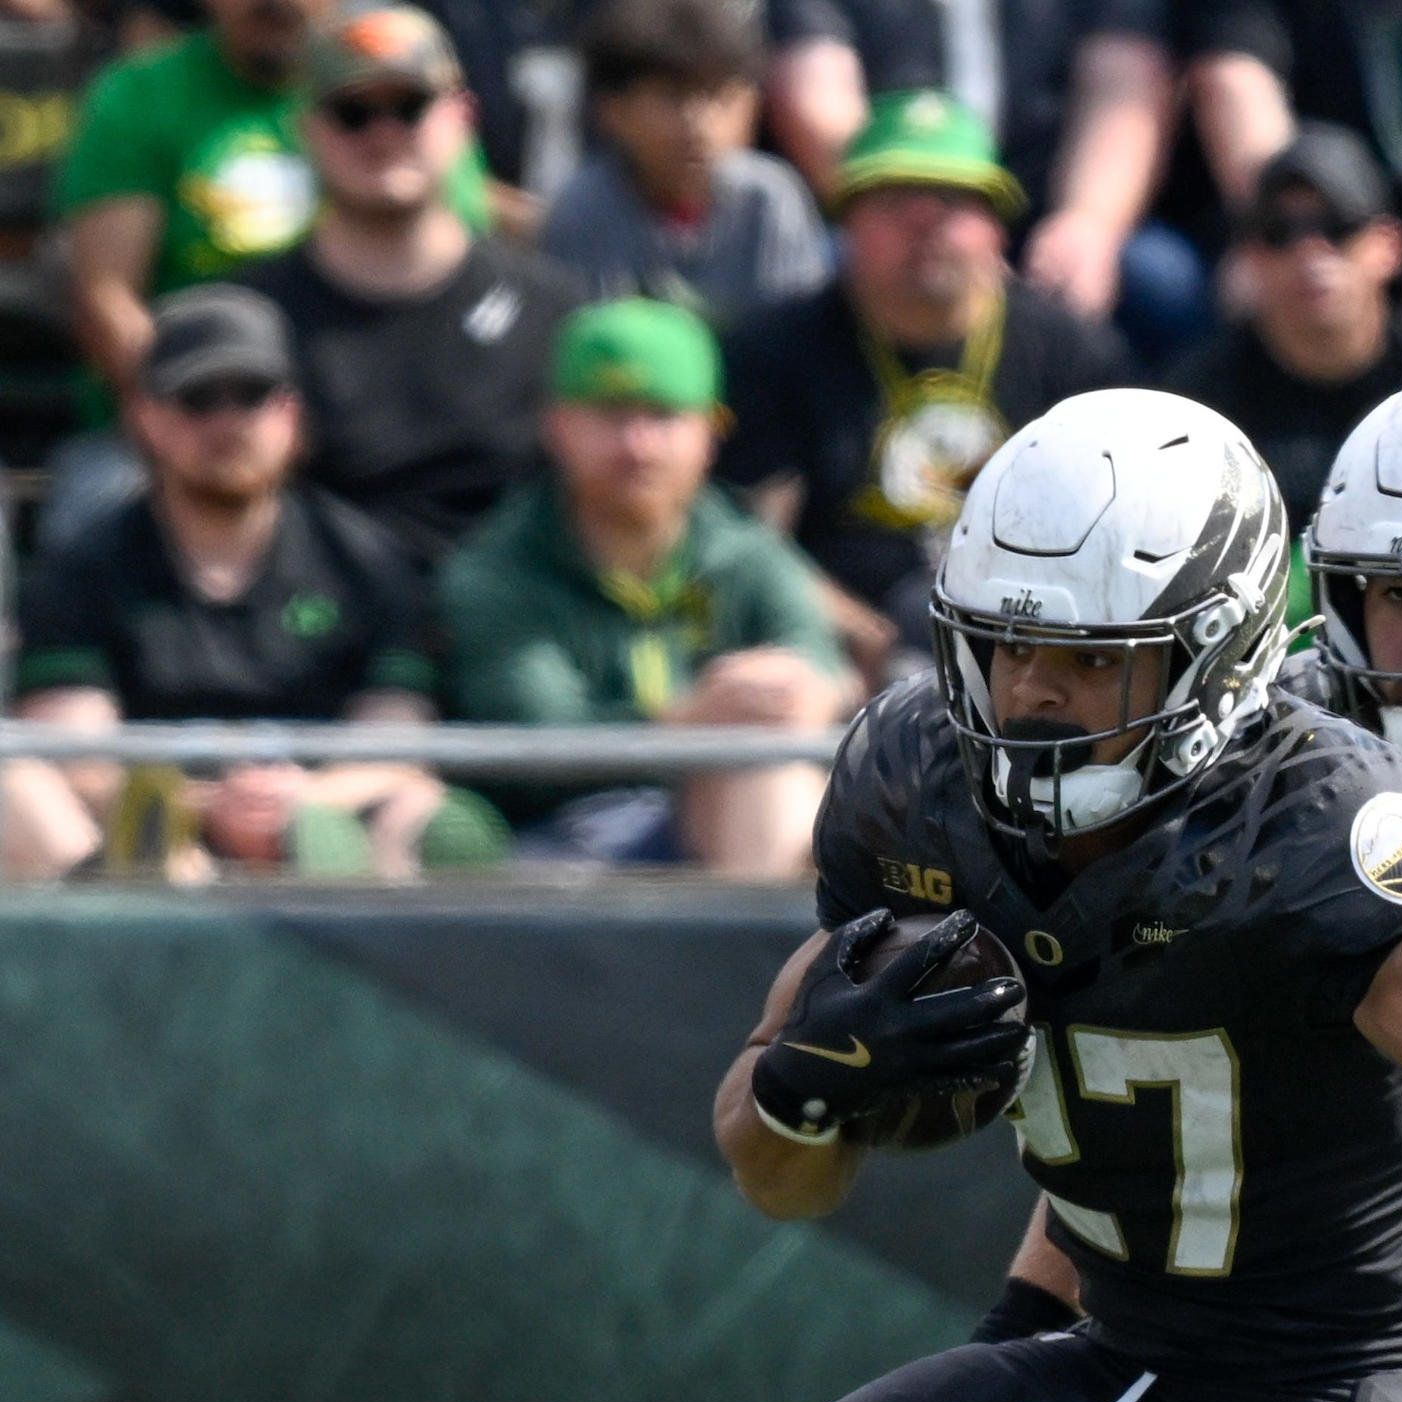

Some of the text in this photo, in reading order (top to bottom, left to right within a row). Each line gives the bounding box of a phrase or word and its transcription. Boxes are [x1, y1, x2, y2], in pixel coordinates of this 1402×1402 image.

[1000, 588, 1043, 618] nike
[1140, 920, 1176, 945] nike
[1023, 929, 1064, 967] O
